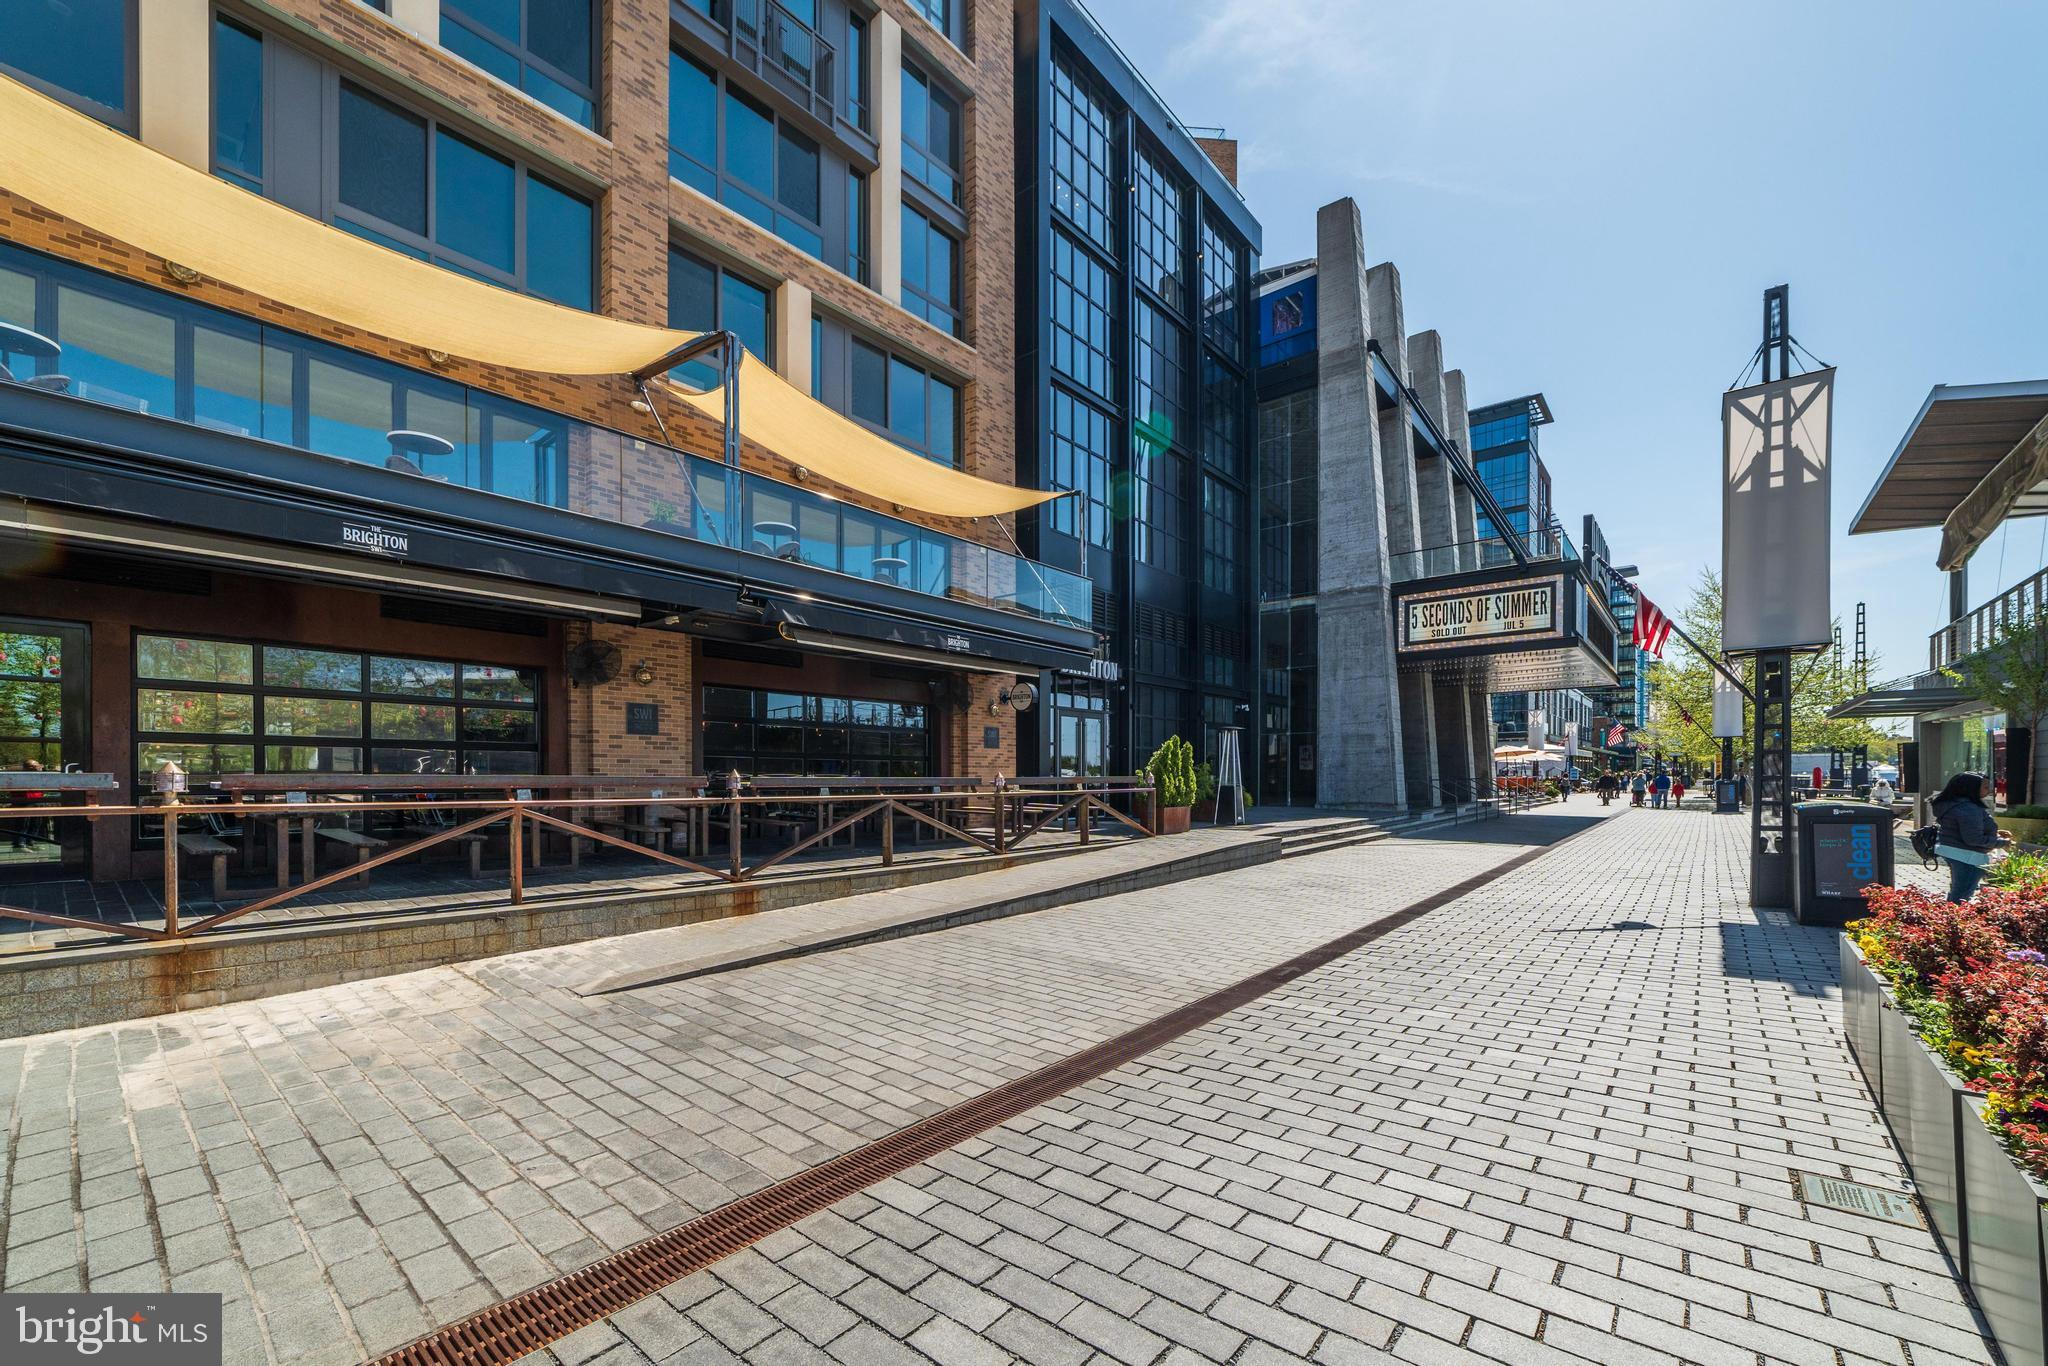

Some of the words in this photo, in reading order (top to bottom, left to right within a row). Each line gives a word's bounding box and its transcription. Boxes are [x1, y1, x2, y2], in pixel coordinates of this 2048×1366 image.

[371, 525, 382, 533] THE
[343, 527, 408, 551] BRIGHTON
[1412, 606, 1418, 629] 5
[1422, 599, 1473, 628] SECONDS
[1477, 597, 1491, 622] OF
[1495, 590, 1548, 620] SUMMER
[1431, 628, 1450, 638] SOLD
[1452, 626, 1467, 636] OUT
[1503, 620, 1517, 631] JUL
[1519, 620, 1525, 629] 5
[1847, 825, 1873, 880] clean
